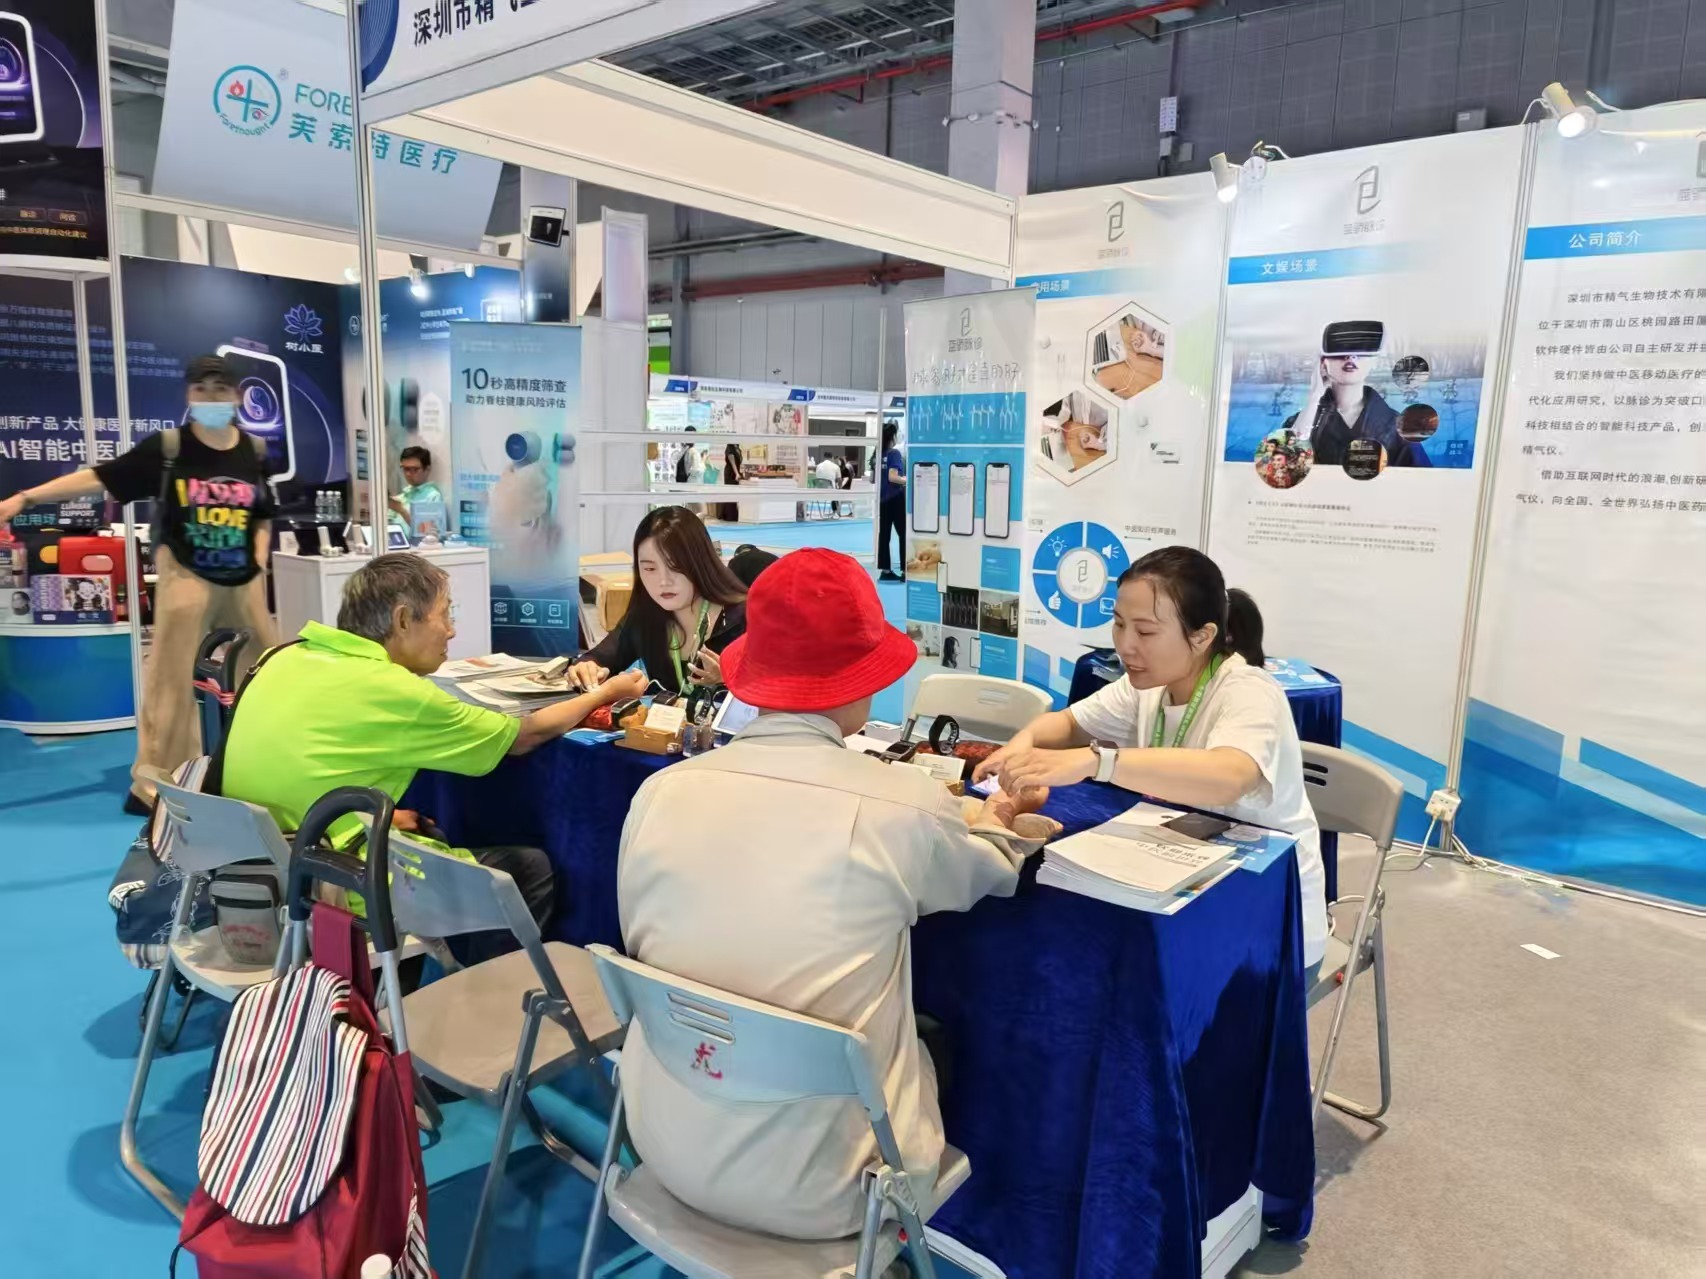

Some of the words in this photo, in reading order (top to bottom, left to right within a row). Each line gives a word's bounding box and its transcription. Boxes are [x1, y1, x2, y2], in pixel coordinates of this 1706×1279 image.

[288, 112, 457, 174] 芙索特医疗
[1568, 230, 1641, 249] 公司简介
[1262, 258, 1318, 275] 文娱场景
[461, 367, 567, 393] 10秒高精度筛查
[465, 394, 567, 409] 助力脊柱健康风险评估
[1528, 395, 1706, 407] 代化应用研究，以脉诊为突破口
[1525, 420, 1706, 433] 科技相结合的智能科技产品，创
